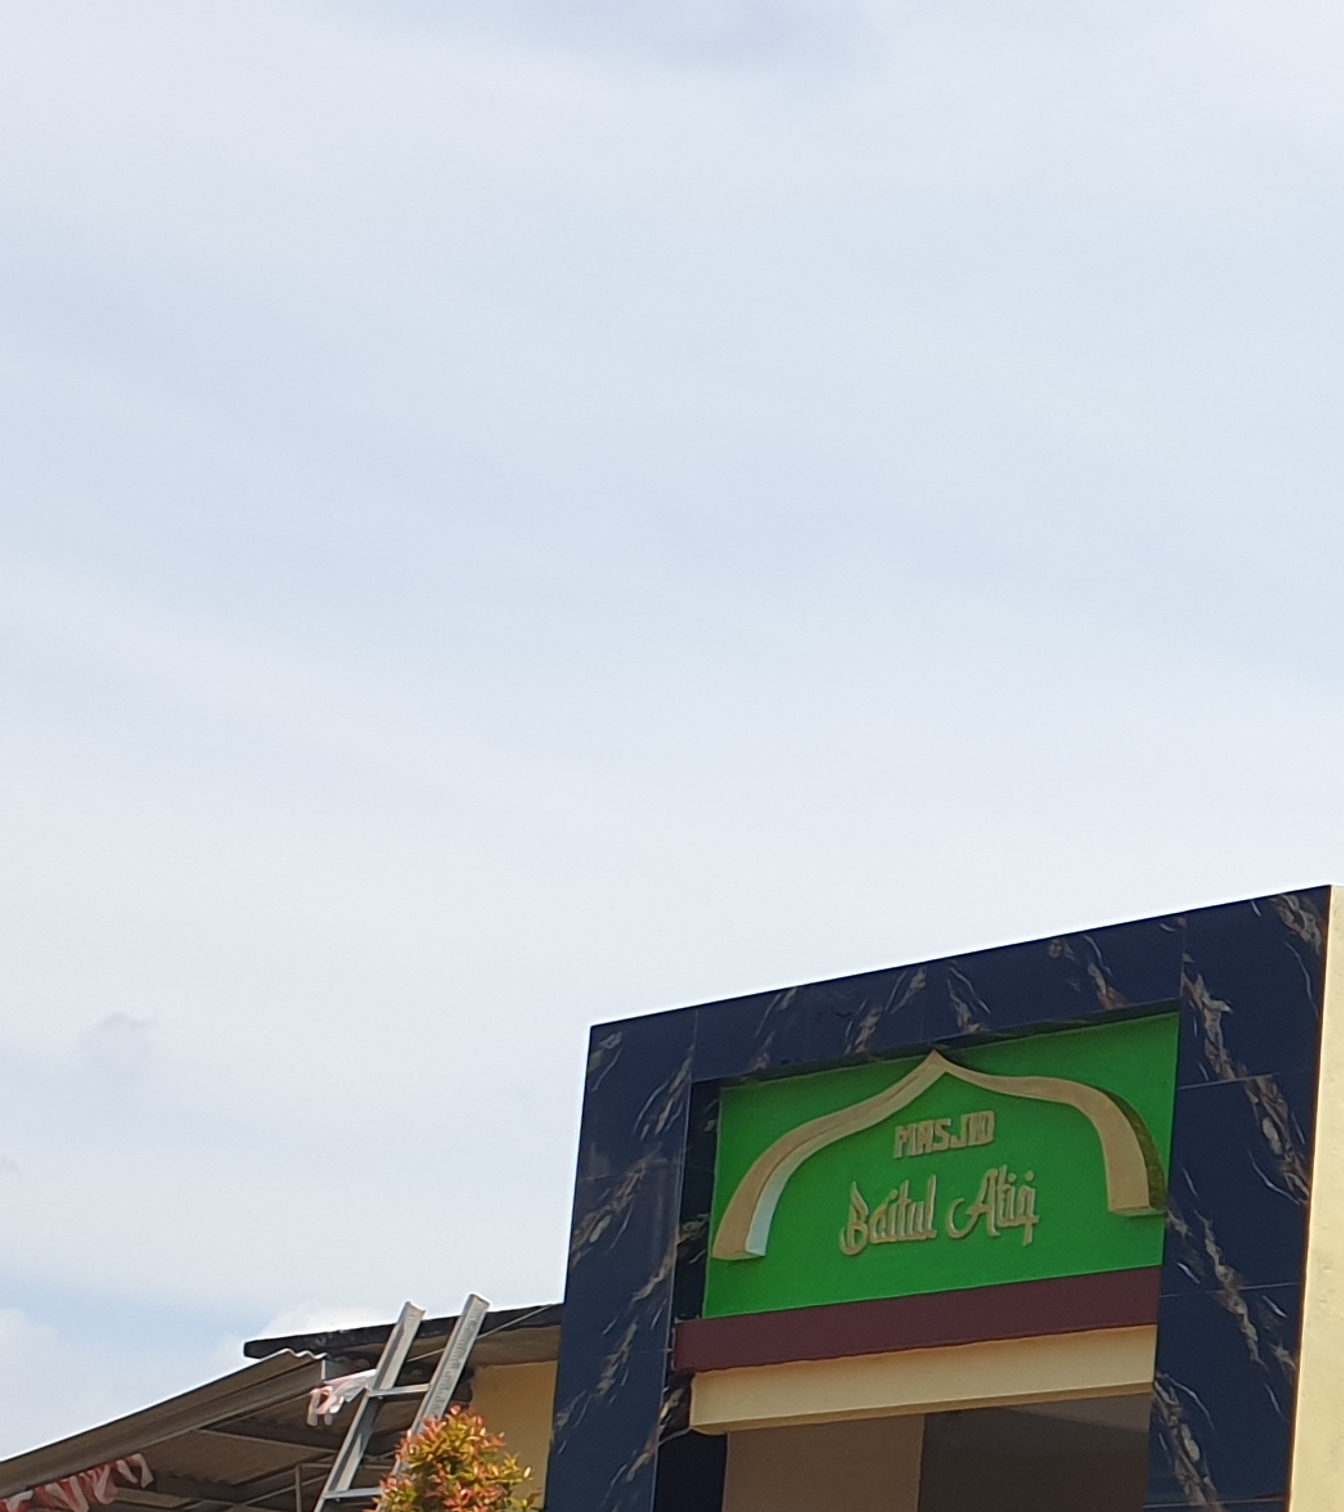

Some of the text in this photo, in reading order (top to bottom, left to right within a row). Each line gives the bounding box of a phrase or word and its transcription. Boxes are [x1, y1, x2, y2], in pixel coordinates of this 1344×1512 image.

[893, 1110, 995, 1159] MASJID
[839, 1164, 1040, 1256] Baitul Atiq
